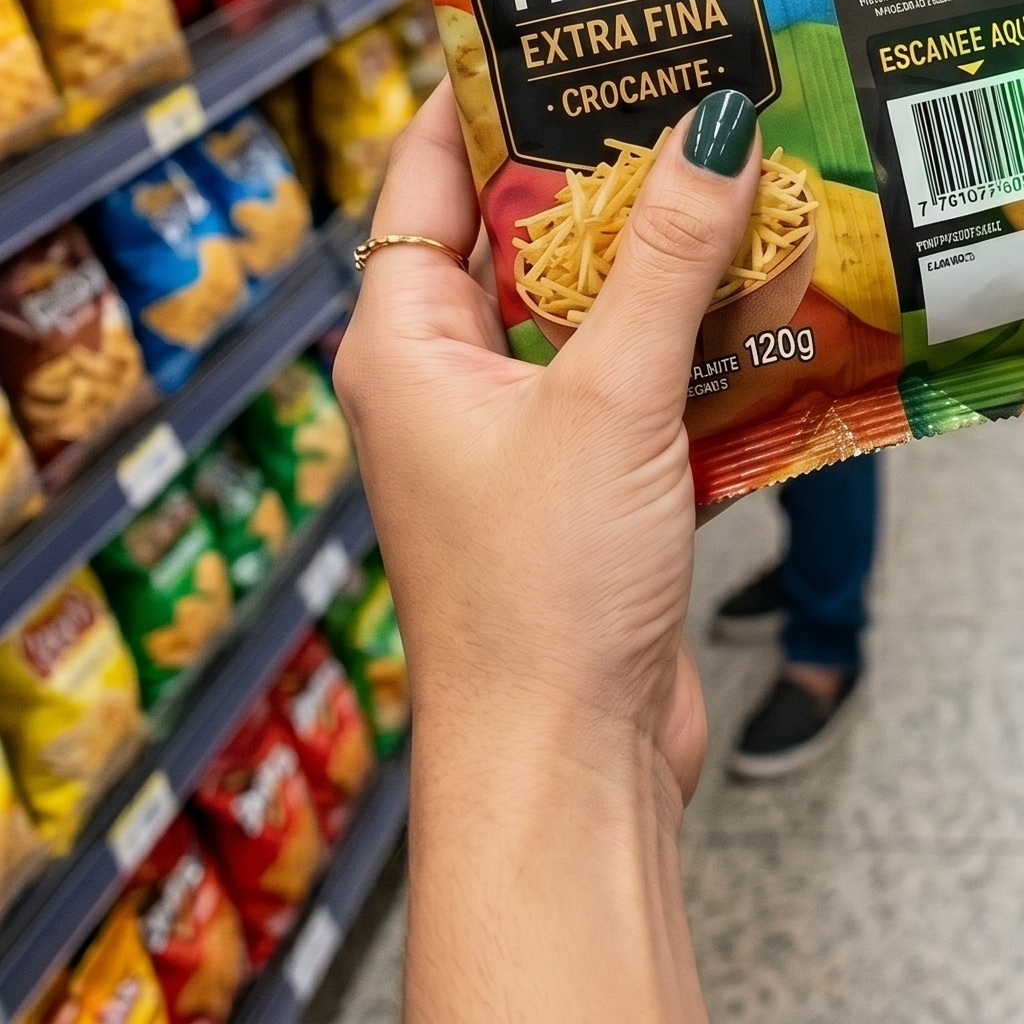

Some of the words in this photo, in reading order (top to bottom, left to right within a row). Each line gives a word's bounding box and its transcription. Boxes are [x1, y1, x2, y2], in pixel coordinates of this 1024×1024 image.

[520, 14, 638, 69] EXTRA
[879, 26, 986, 73] ESCANEE
[562, 59, 712, 117] CROCANTE
[744, 328, 815, 366] 120g
